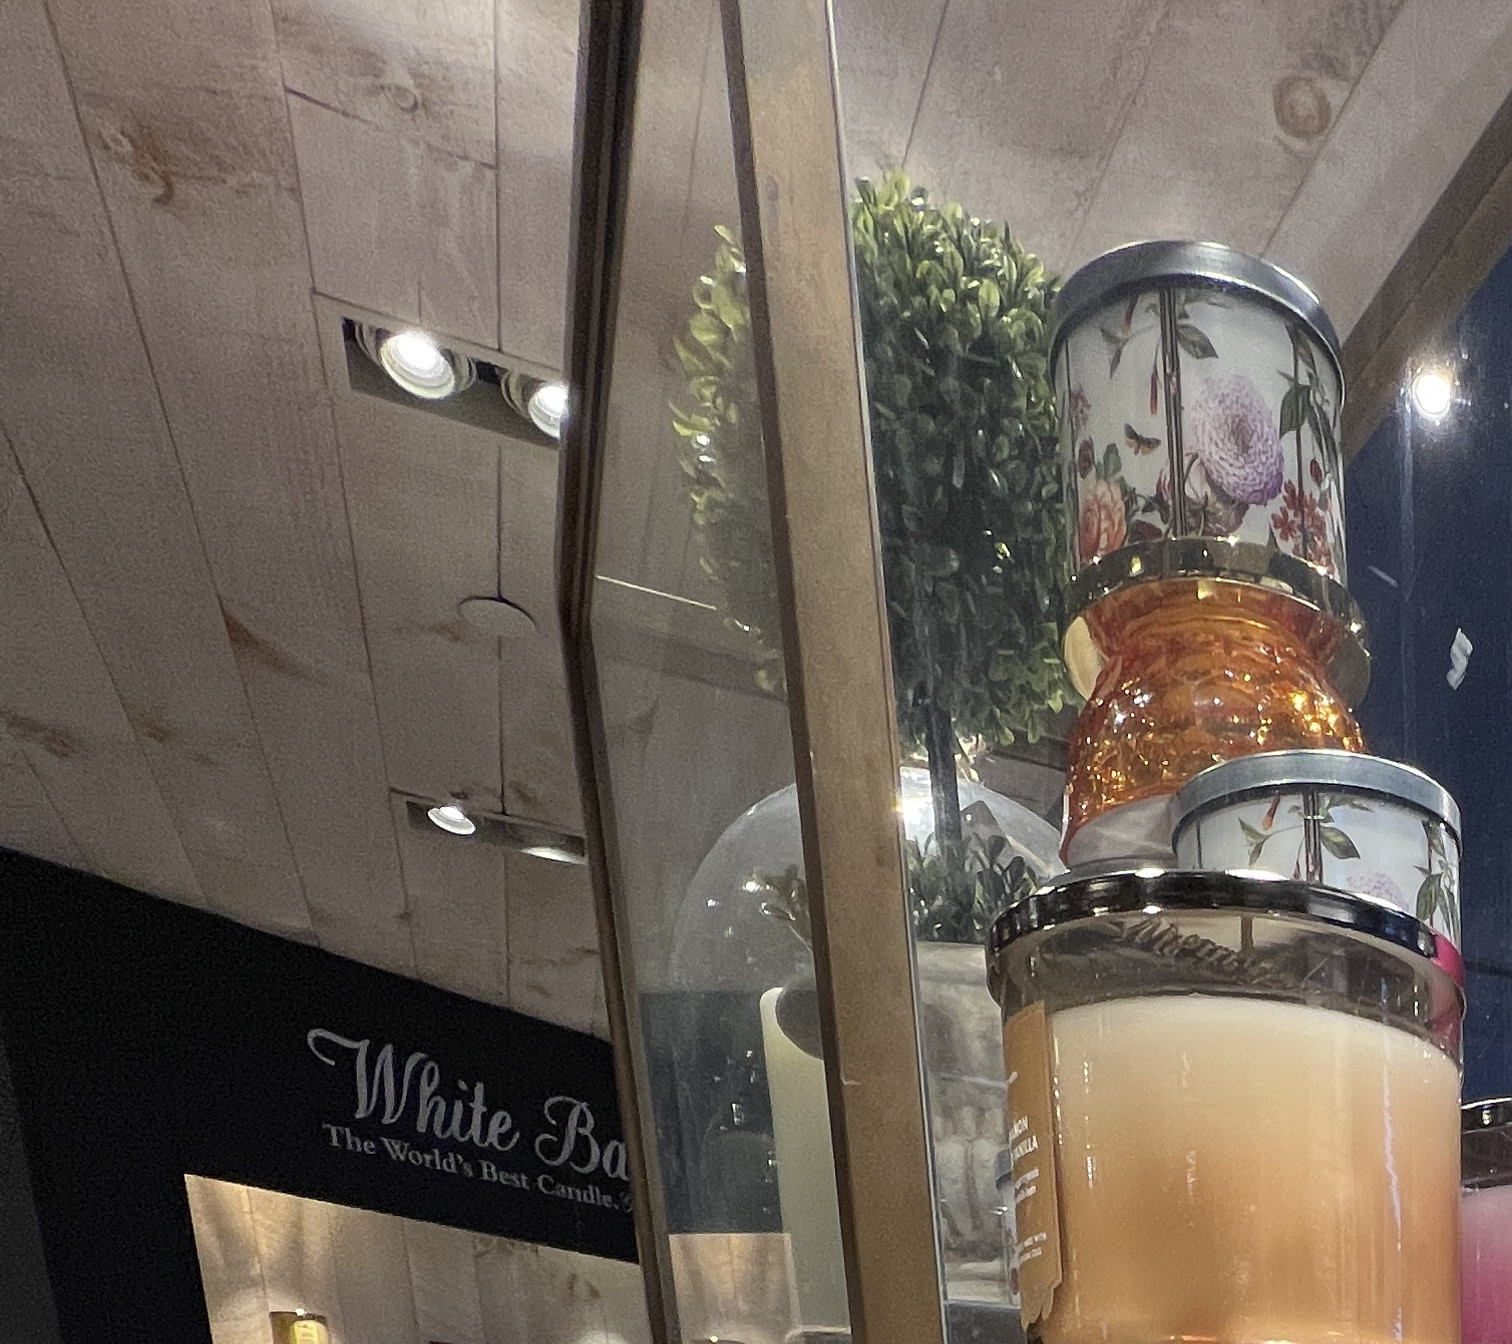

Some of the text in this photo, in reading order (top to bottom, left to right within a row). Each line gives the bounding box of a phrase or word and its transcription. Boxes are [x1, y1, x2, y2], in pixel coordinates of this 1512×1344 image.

[307, 1028, 629, 1181] White Ba
[322, 1123, 376, 1154] The
[381, 1136, 472, 1178] World's
[479, 1159, 530, 1190] Best
